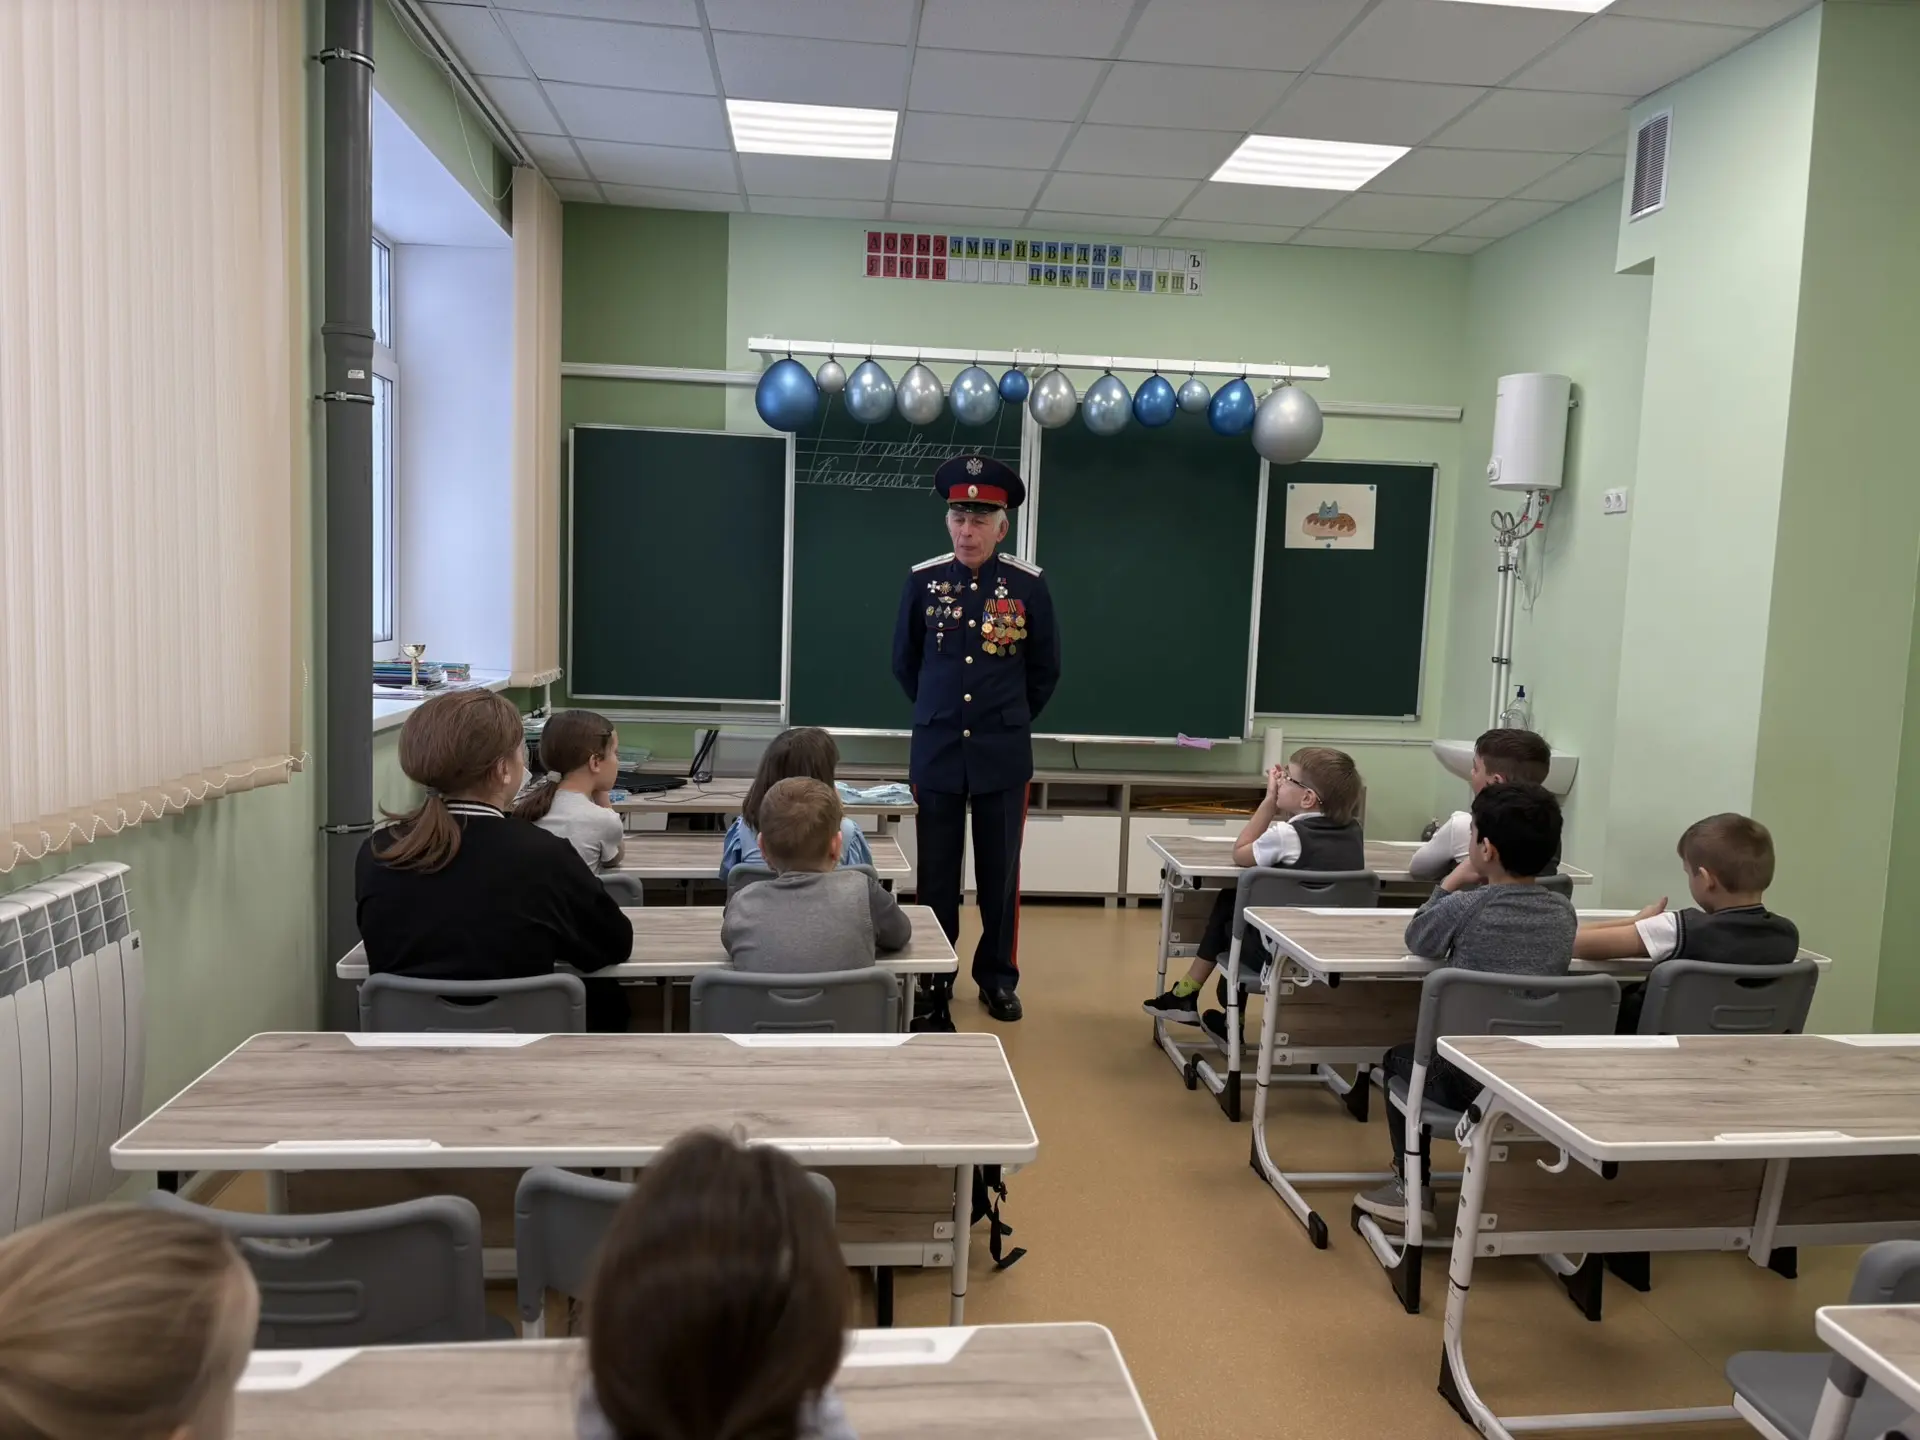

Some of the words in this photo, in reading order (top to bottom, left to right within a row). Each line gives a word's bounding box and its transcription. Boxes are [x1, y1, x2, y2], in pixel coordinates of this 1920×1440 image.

[869, 236, 878, 249] А
[886, 236, 895, 250] О
[902, 238, 912, 251] У
[918, 239, 931, 251] Ы
[935, 240, 945, 253] Э
[951, 240, 962, 253] Л
[967, 241, 979, 254] М
[984, 242, 994, 255] Н
[1000, 243, 1010, 256] Р
[1016, 240, 1026, 257] Й
[1031, 245, 1040, 258] Б
[1048, 245, 1056, 259] В
[1064, 246, 1072, 260] Г
[1077, 247, 1088, 264] Д
[1093, 248, 1106, 262] Ж
[1111, 249, 1119, 263] З
[1190, 254, 1200, 268] Ъ
[868, 259, 878, 273] Я
[887, 256, 894, 273] Ё
[900, 261, 913, 274] Ю
[918, 261, 928, 275] И
[935, 263, 945, 276] Е
[1030, 268, 1040, 281] П
[1045, 268, 1056, 282] Ф
[1060, 270, 1071, 283] К
[1077, 270, 1087, 284] Т
[1092, 271, 1104, 285] Ш
[1110, 272, 1118, 286] С
[1125, 273, 1136, 287] Х
[1141, 274, 1152, 290] Ц
[1158, 276, 1167, 289] Ч
[1171, 276, 1184, 290] Щ
[1189, 277, 1198, 290] Ь
[814, 456, 921, 488] Классная
